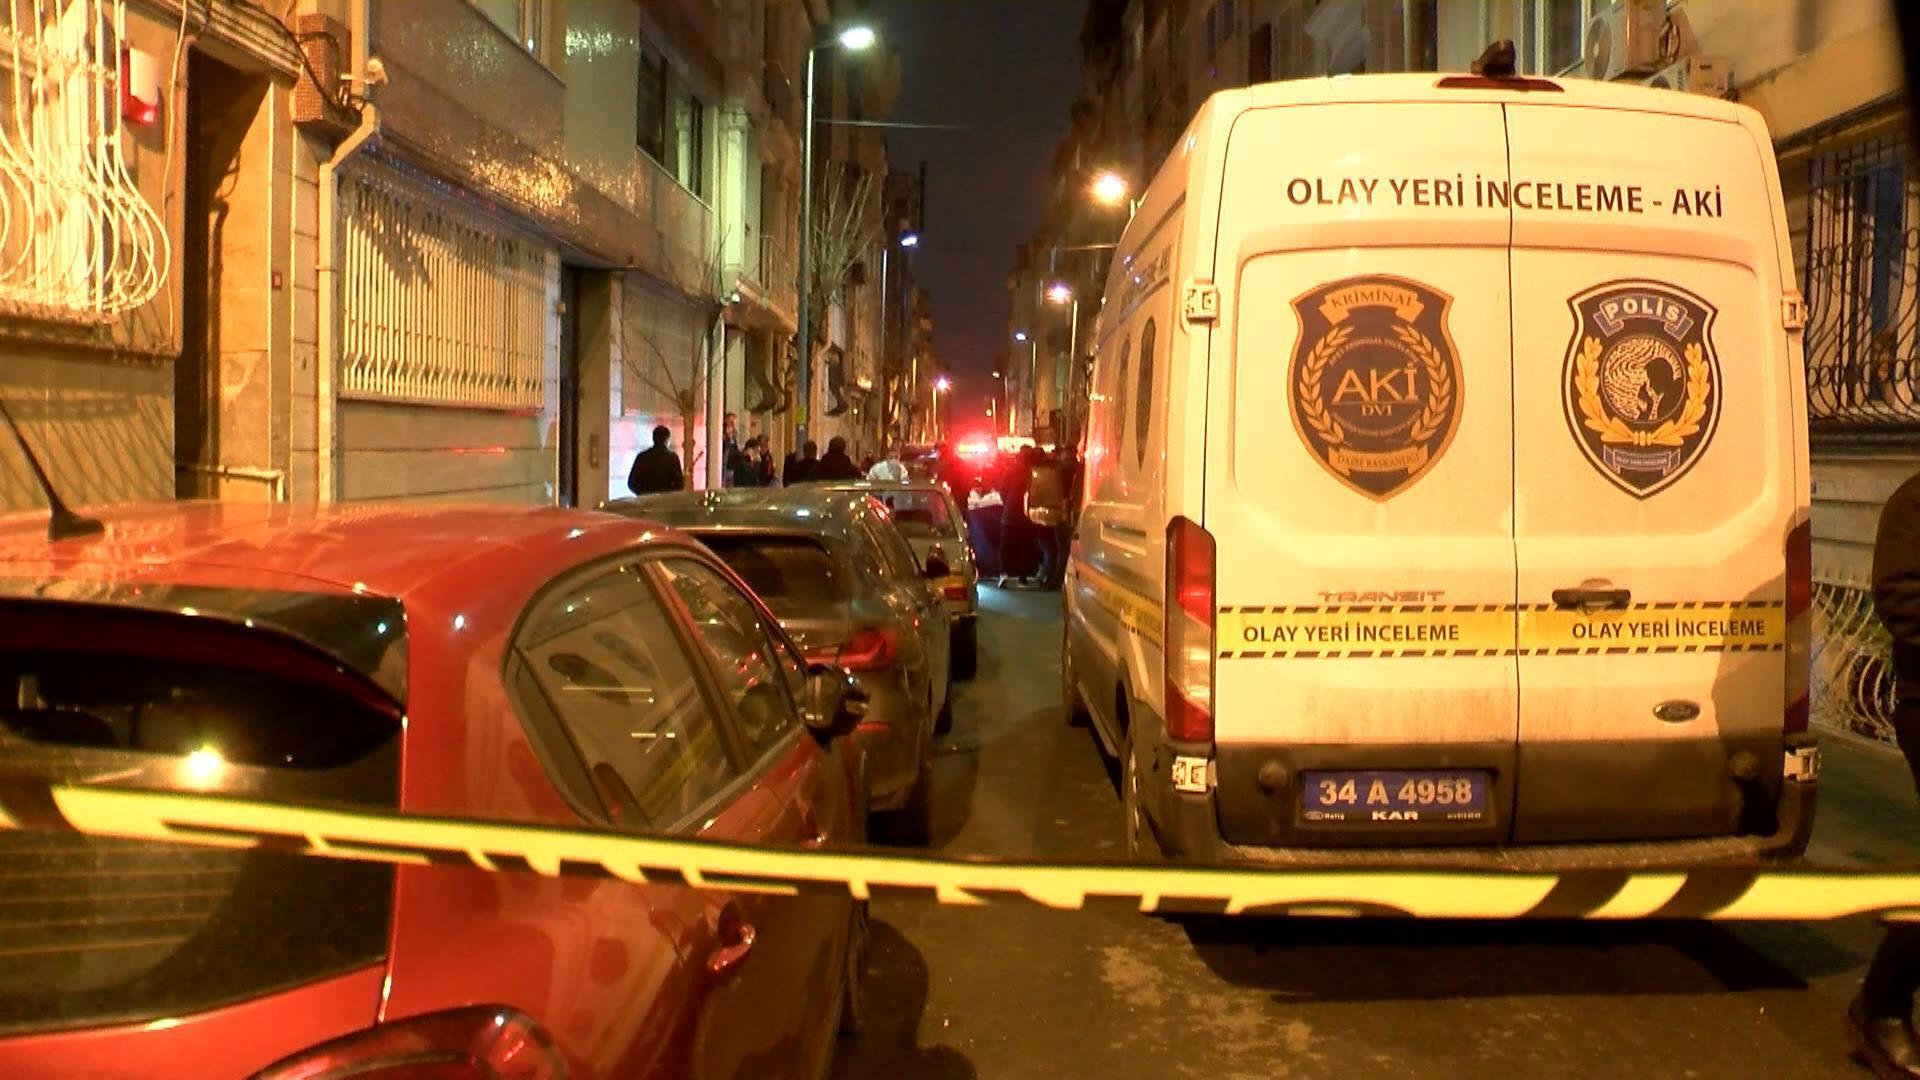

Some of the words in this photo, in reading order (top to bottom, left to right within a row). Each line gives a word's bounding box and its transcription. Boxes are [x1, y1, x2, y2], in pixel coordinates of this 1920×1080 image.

[1287, 177, 1379, 206] OLAY
[1389, 173, 1464, 207] YERİ
[1476, 173, 1643, 214] İNCELEME
[1672, 185, 1723, 218] AKİ
[1331, 286, 1415, 309] KRİMİNAL
[1603, 297, 1680, 323] POLİS
[1331, 361, 1418, 401] AKİ
[1317, 590, 1446, 603] TRANSIT
[1243, 625, 1298, 643] OLAY
[1304, 621, 1350, 642] YERİ
[1356, 621, 1460, 642] İNCELEME
[1572, 622, 1623, 639] OLAY
[1629, 618, 1669, 638] YERİ
[1675, 617, 1765, 637] İNCELEME
[1319, 778, 1358, 805] 34
[1366, 778, 1390, 805] A
[1398, 778, 1473, 805] 4958
[1371, 810, 1419, 821] KAR
